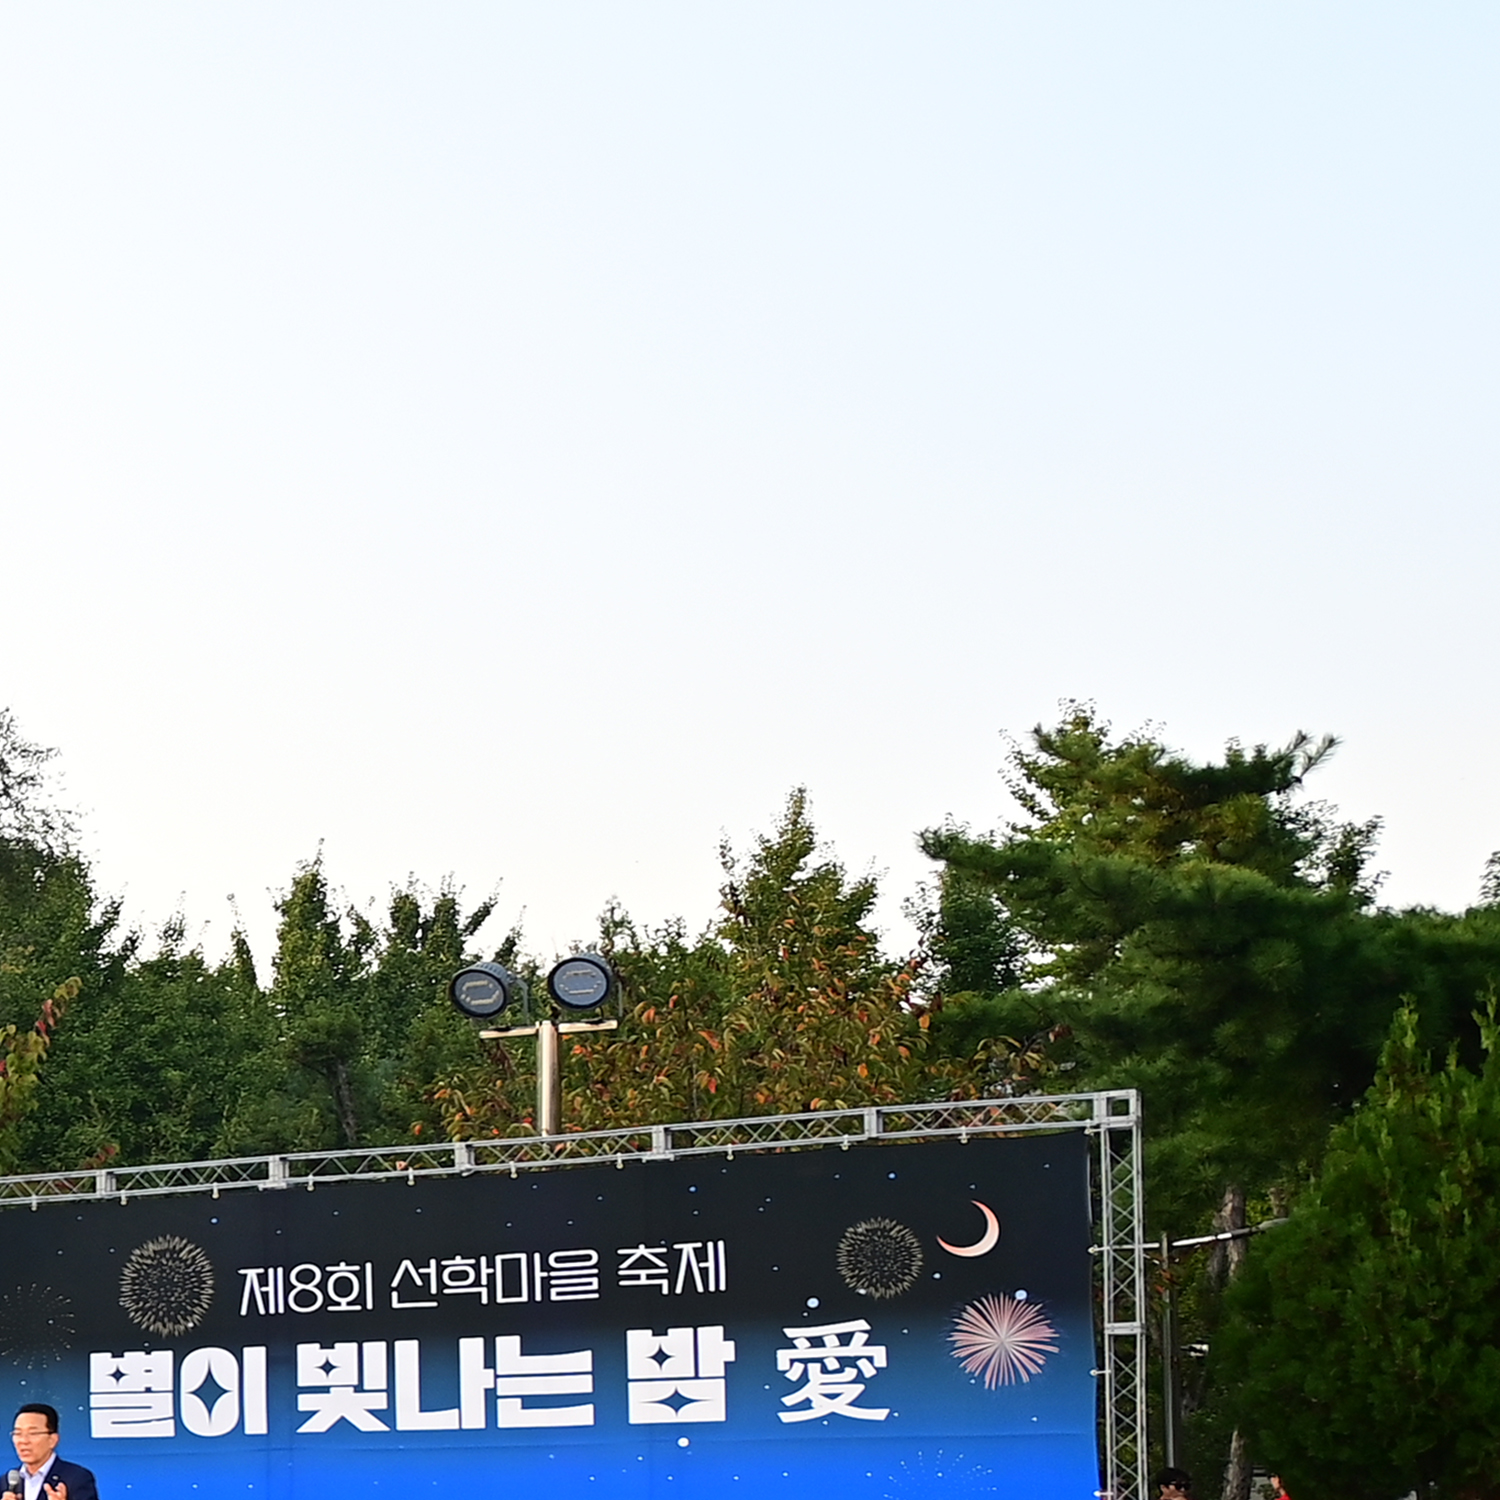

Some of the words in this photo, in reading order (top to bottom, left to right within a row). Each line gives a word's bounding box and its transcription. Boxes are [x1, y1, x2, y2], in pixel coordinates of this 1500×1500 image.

[237, 1262, 374, 1316] 제8회
[390, 1249, 600, 1309] 선학마을
[616, 1240, 727, 1295] 축제
[88, 1346, 268, 1439] 별이
[295, 1335, 596, 1435] 빛나는
[625, 1325, 736, 1425] 밤
[775, 1318, 889, 1424] 愛
